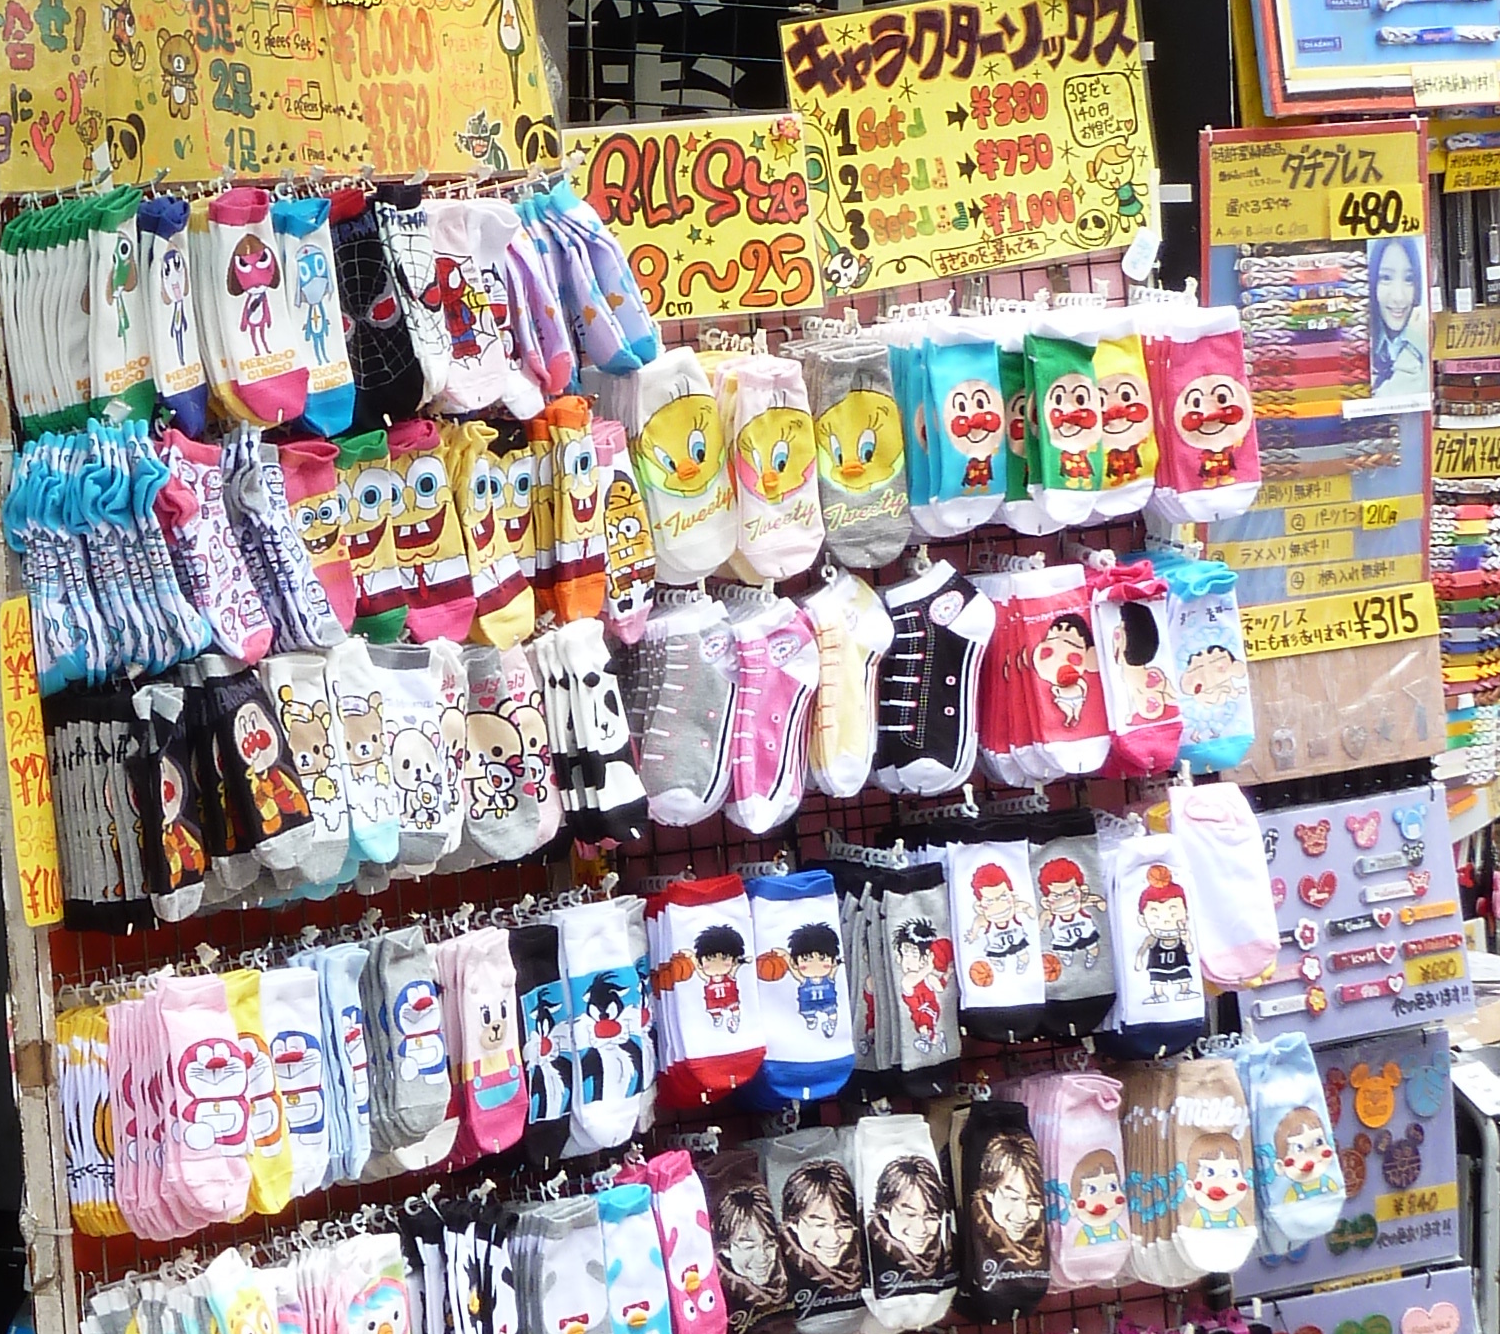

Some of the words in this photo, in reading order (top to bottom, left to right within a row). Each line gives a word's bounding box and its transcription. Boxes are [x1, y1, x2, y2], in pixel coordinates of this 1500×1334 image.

[970, 81, 1049, 130] ¥380
[835, 109, 857, 157] 1
[857, 105, 908, 151] Set
[977, 135, 1054, 180] ¥750
[692, 137, 809, 225] Size
[841, 165, 863, 205] 2
[862, 160, 912, 202] Set
[868, 205, 918, 245] Set
[744, 501, 817, 543] Tweety
[823, 488, 909, 531] Tweety
[1353, 593, 1420, 640] ¥315
[1174, 1094, 1252, 1139] Milky
